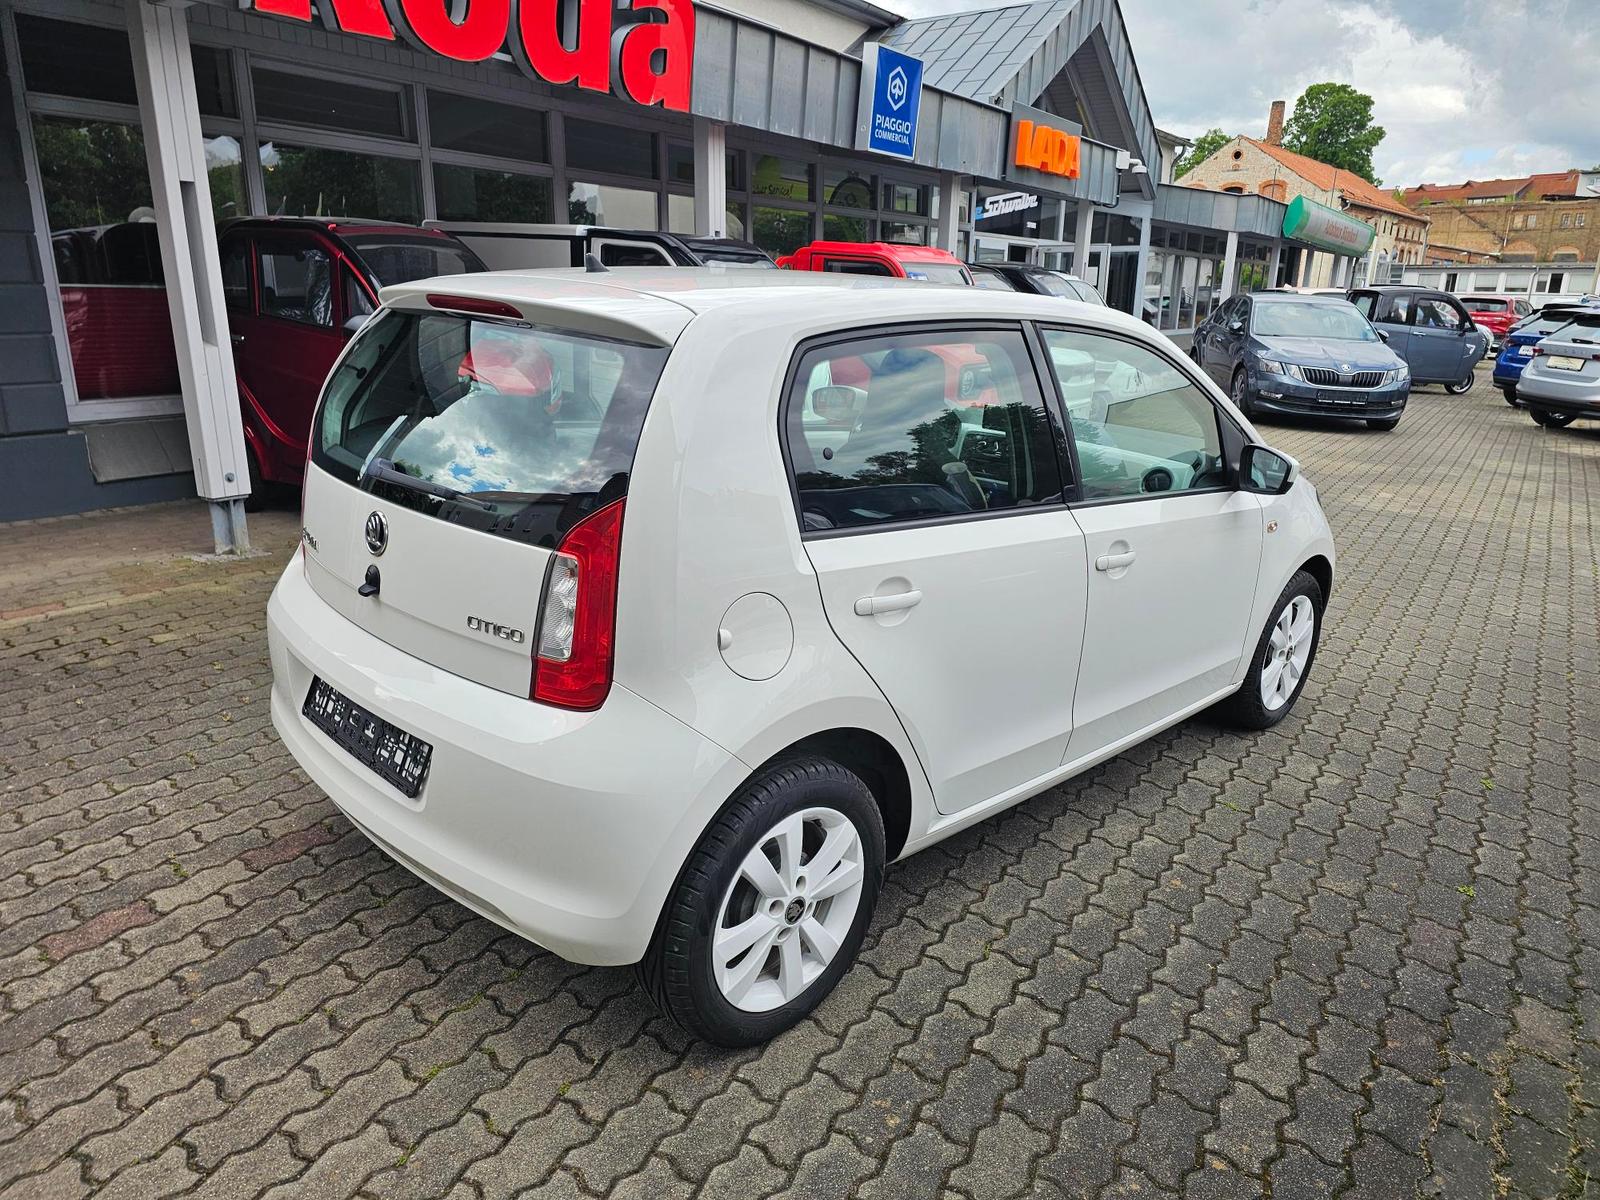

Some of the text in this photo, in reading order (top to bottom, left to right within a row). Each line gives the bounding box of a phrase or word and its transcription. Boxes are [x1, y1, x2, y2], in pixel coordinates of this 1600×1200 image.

[875, 114, 912, 134] PIAGGIO
[874, 129, 910, 145] COMMERCIAL
[1016, 119, 1081, 179] LADA
[467, 615, 525, 644] CITIGO
